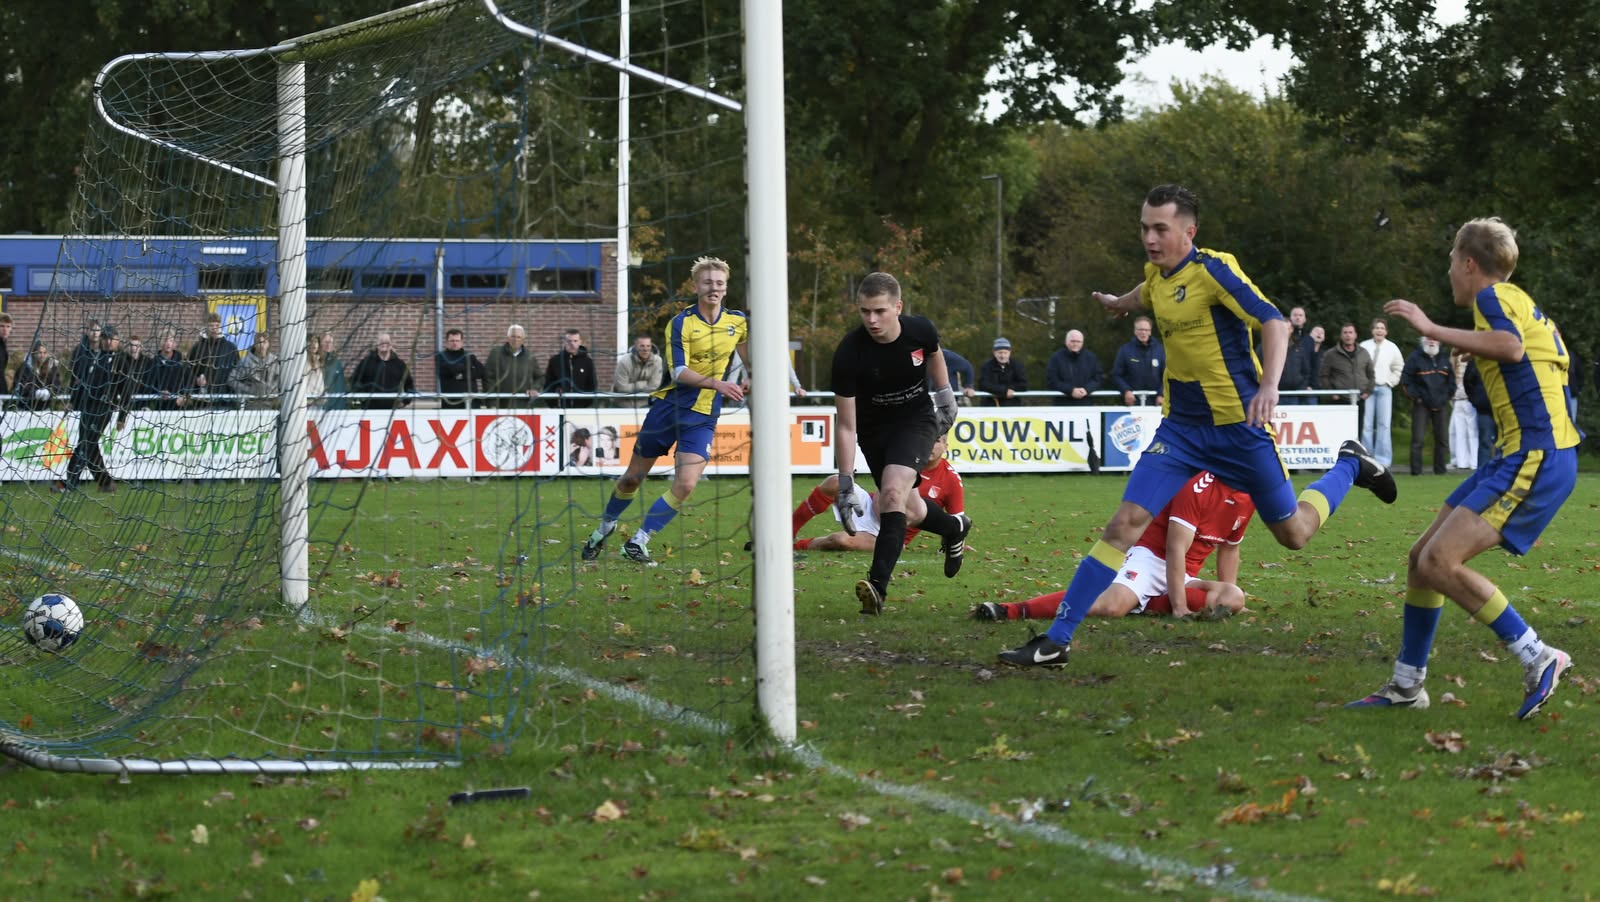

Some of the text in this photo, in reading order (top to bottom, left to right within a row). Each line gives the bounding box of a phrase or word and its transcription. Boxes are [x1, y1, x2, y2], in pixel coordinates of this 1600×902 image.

[133, 427, 270, 455] Brouwer
[954, 420, 1084, 443] OUW.NL
[1272, 421, 1320, 445] MA
[307, 419, 469, 470] AJAX
[968, 449, 1002, 460] VAN
[1010, 448, 1061, 460] TOUW
[1282, 457, 1337, 465] ALSMA.NL
